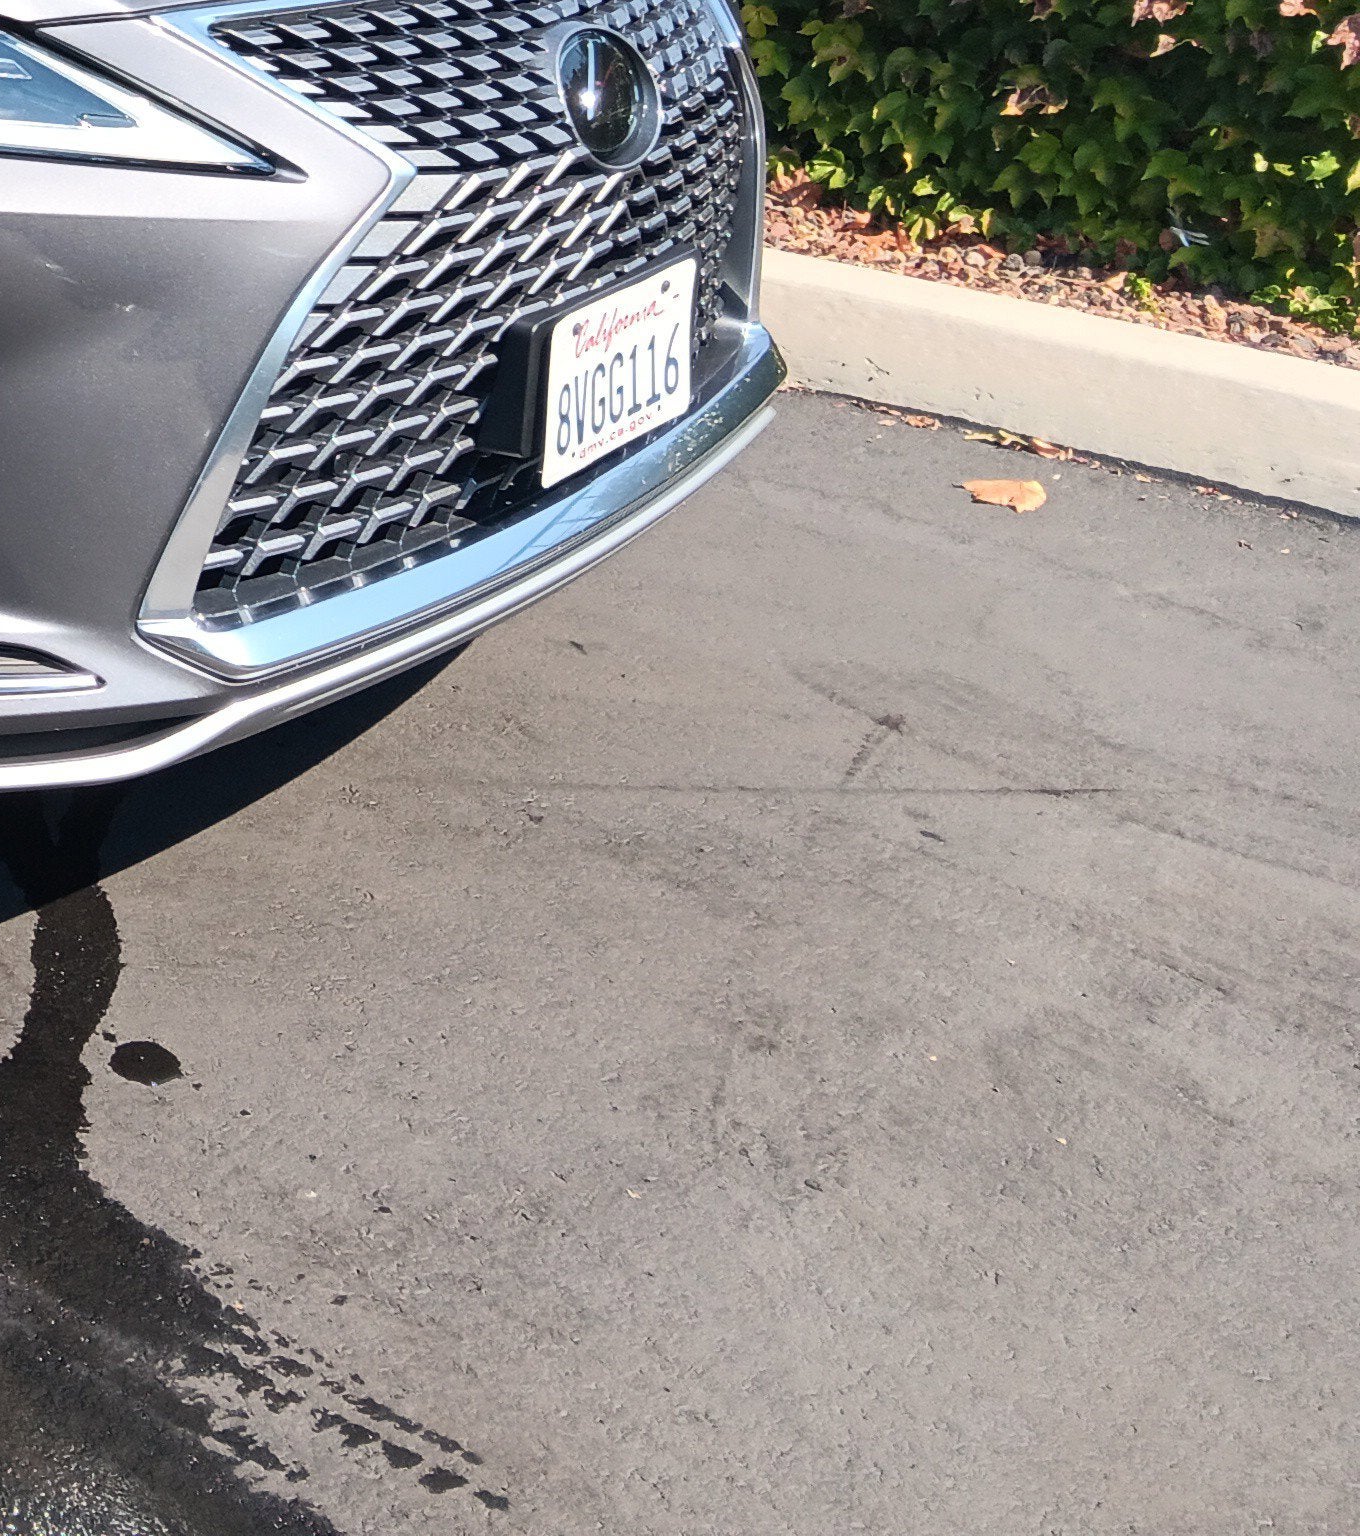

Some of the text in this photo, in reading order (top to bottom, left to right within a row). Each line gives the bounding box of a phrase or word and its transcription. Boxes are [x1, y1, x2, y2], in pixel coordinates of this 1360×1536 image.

[574, 300, 664, 359] California
[556, 322, 679, 456] 8VGG116
[579, 413, 653, 459] dmv.ca.gov
